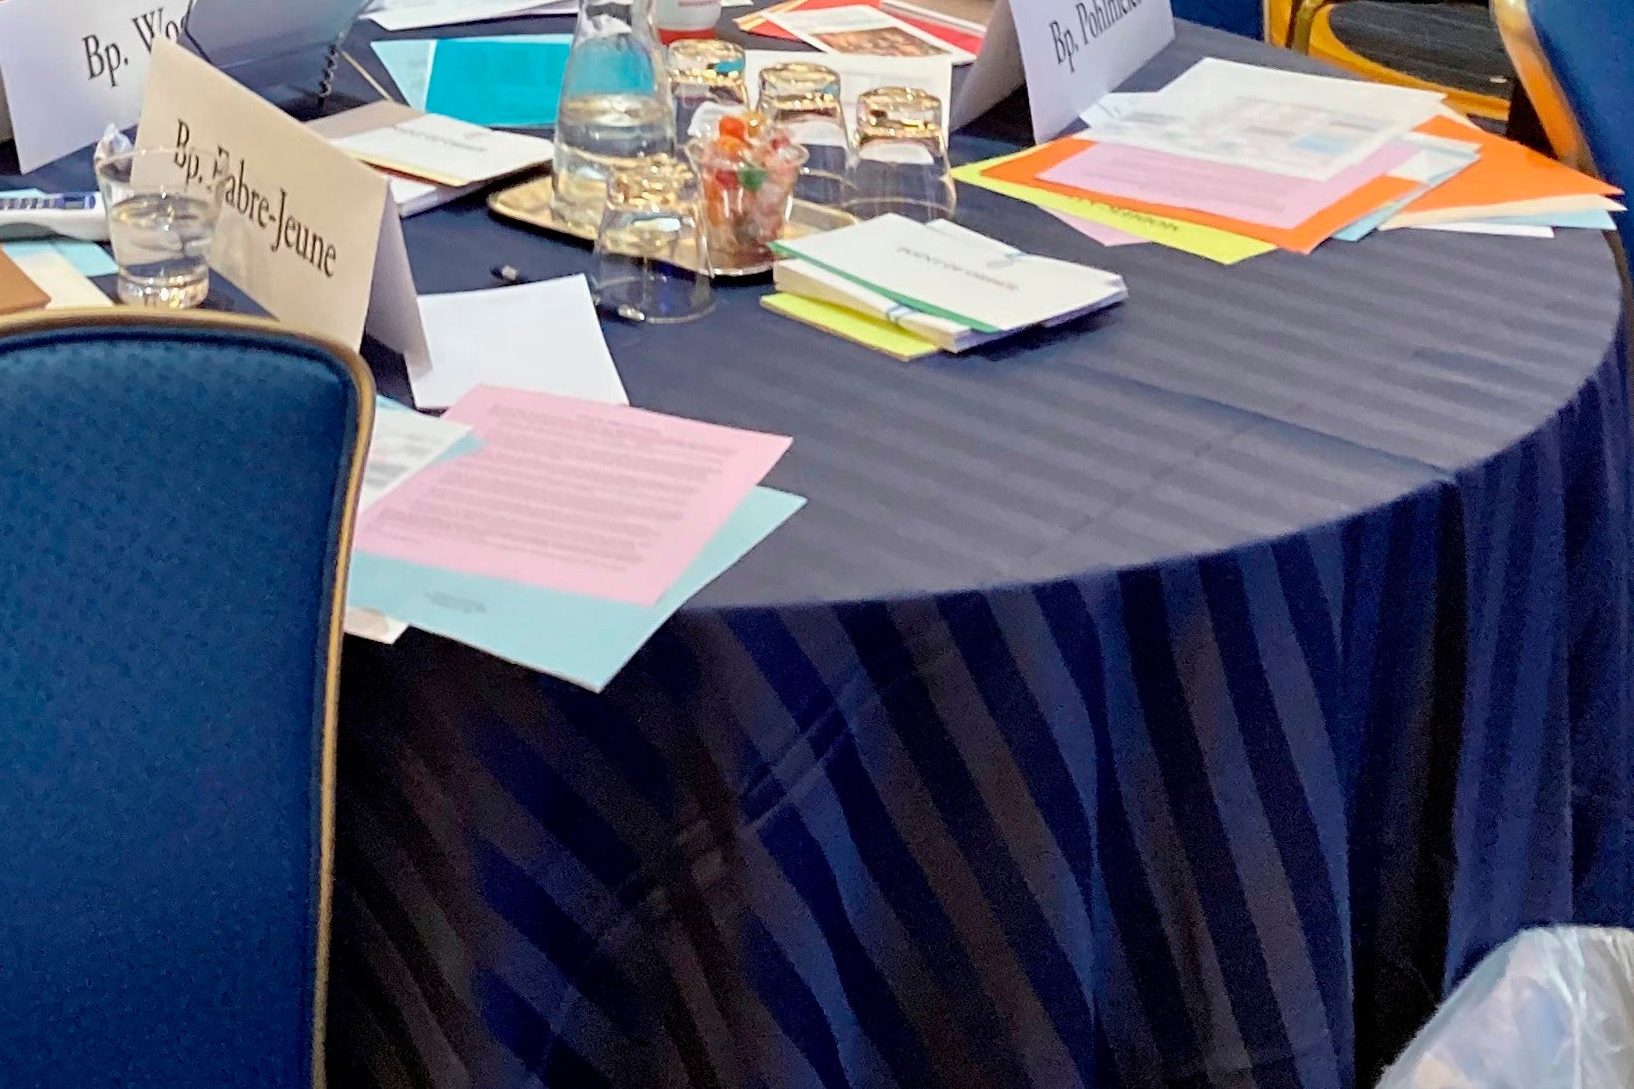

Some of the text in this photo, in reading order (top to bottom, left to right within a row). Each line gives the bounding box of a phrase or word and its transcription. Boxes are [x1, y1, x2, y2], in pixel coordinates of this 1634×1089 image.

[82, 7, 186, 88] Bp. Wo
[1049, 20, 1079, 74] Bp.
[173, 118, 203, 187] Bp.
